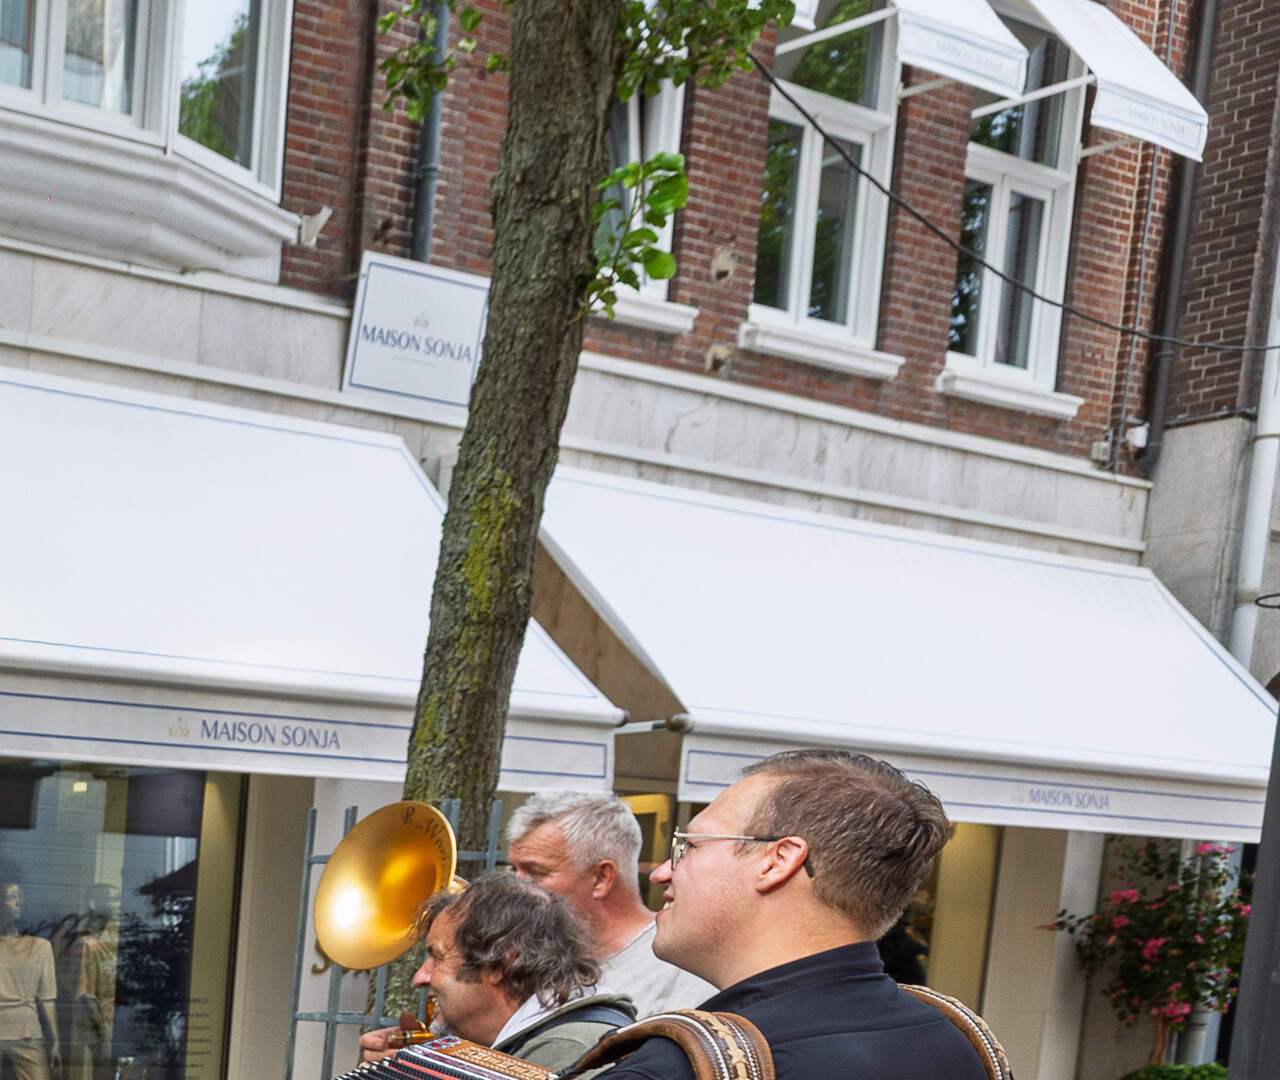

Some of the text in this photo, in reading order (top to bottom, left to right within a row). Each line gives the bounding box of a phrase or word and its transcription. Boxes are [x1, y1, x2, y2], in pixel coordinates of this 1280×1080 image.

[362, 323, 422, 352] MAISON
[423, 336, 472, 362] SONJA
[200, 719, 341, 749] MAISON SONJA
[1029, 788, 1111, 809] MAISON SONJA
